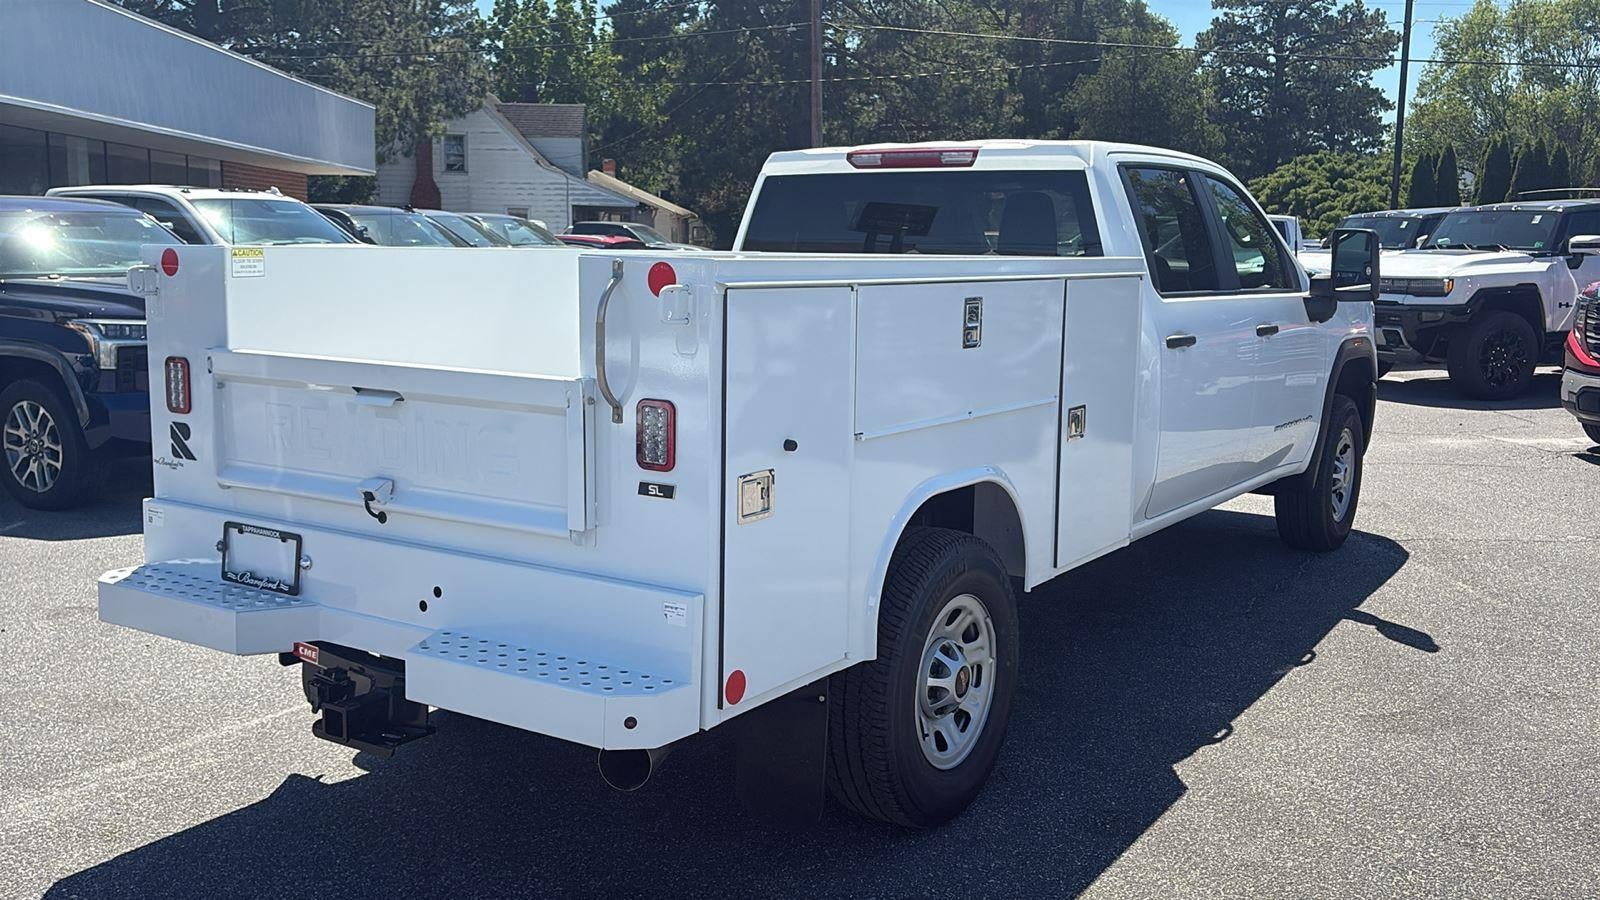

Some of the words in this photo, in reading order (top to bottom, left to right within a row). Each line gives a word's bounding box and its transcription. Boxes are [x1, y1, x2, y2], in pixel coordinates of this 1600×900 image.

[237, 249, 264, 257] CAUTION
[265, 402, 519, 479] REDING
[648, 484, 664, 496] SL
[242, 525, 281, 538] TAPPAHANNOCK
[237, 571, 280, 589] Bareford
[299, 646, 317, 658] CME
